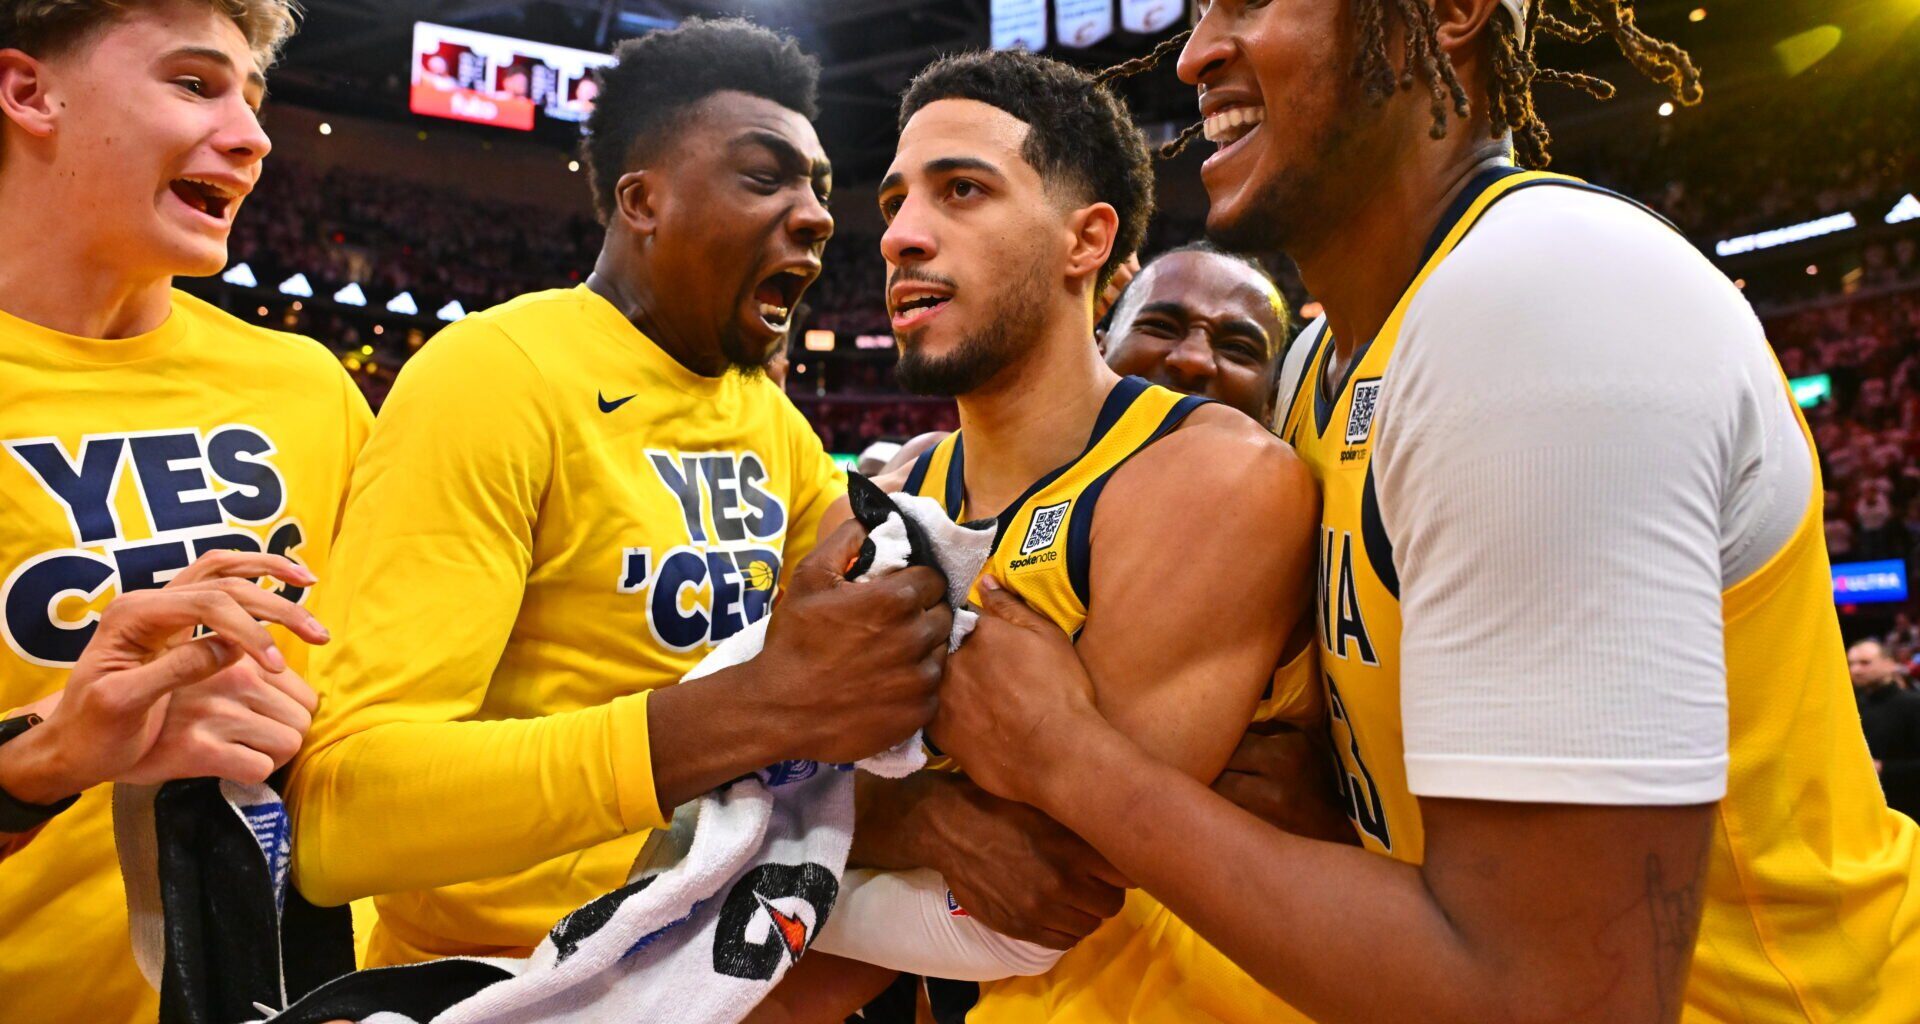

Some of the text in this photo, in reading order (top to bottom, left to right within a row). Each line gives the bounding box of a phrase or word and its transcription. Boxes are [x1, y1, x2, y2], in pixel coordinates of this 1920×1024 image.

[6, 425, 286, 546] YES
[646, 450, 787, 545] YES
[1009, 551, 1057, 571] spokenote
